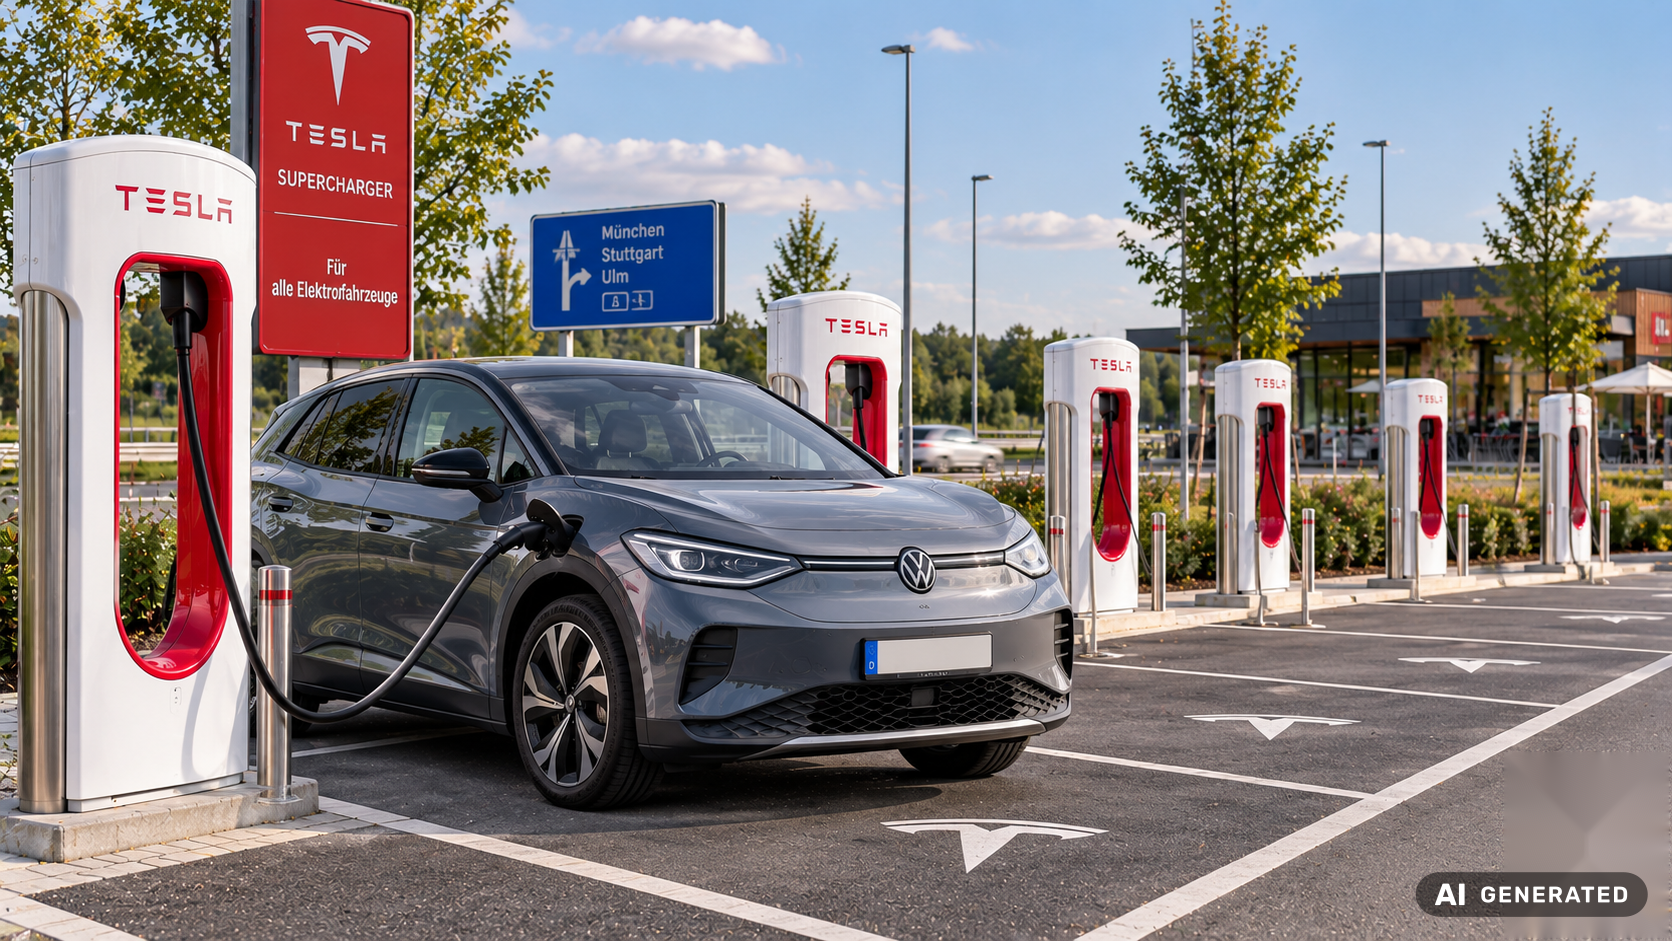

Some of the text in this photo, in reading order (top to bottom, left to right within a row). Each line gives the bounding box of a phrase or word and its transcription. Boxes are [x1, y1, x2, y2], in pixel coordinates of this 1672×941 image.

[285, 120, 386, 154] TESLA
[278, 168, 393, 199] SUPERCHARGER
[115, 184, 232, 224] TESLA
[602, 223, 665, 240] München
[602, 245, 664, 264] Stuttgart
[327, 258, 347, 276] Für
[602, 268, 629, 284] Ulm
[272, 279, 294, 297] alle
[825, 318, 888, 337] TESLA
[1090, 358, 1131, 373] TESLA
[1254, 377, 1286, 390] TESLA
